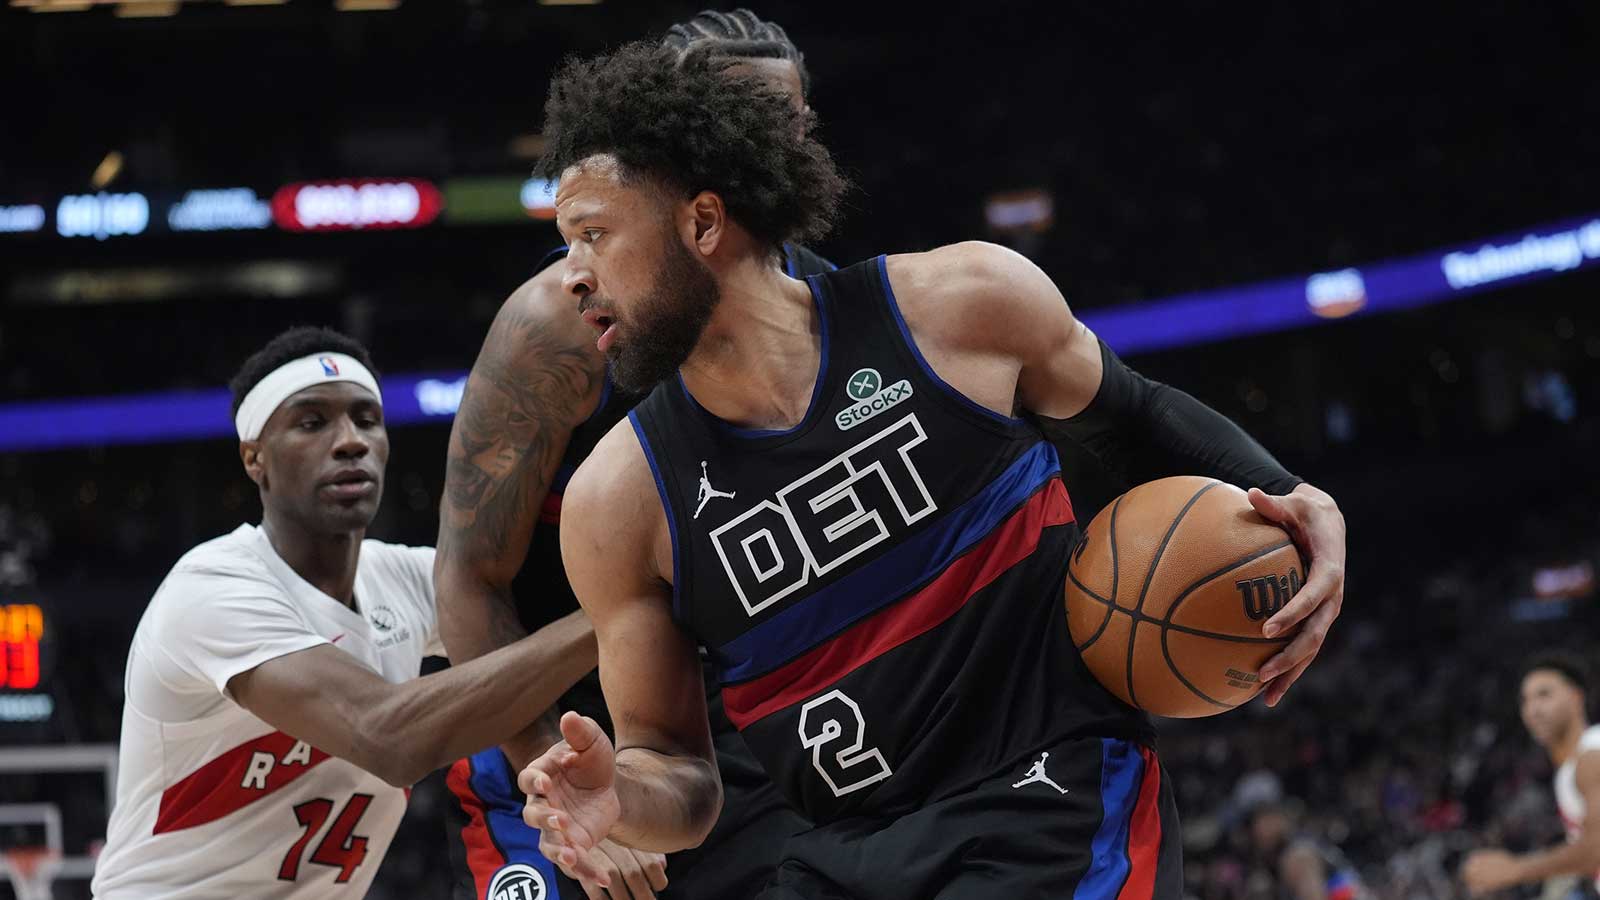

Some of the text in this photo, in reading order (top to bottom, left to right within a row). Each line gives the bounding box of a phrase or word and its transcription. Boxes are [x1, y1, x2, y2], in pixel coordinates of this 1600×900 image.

[838, 382, 911, 427] StockX
[709, 412, 938, 617] DET
[798, 689, 893, 797] 2
[277, 793, 375, 884] 14
